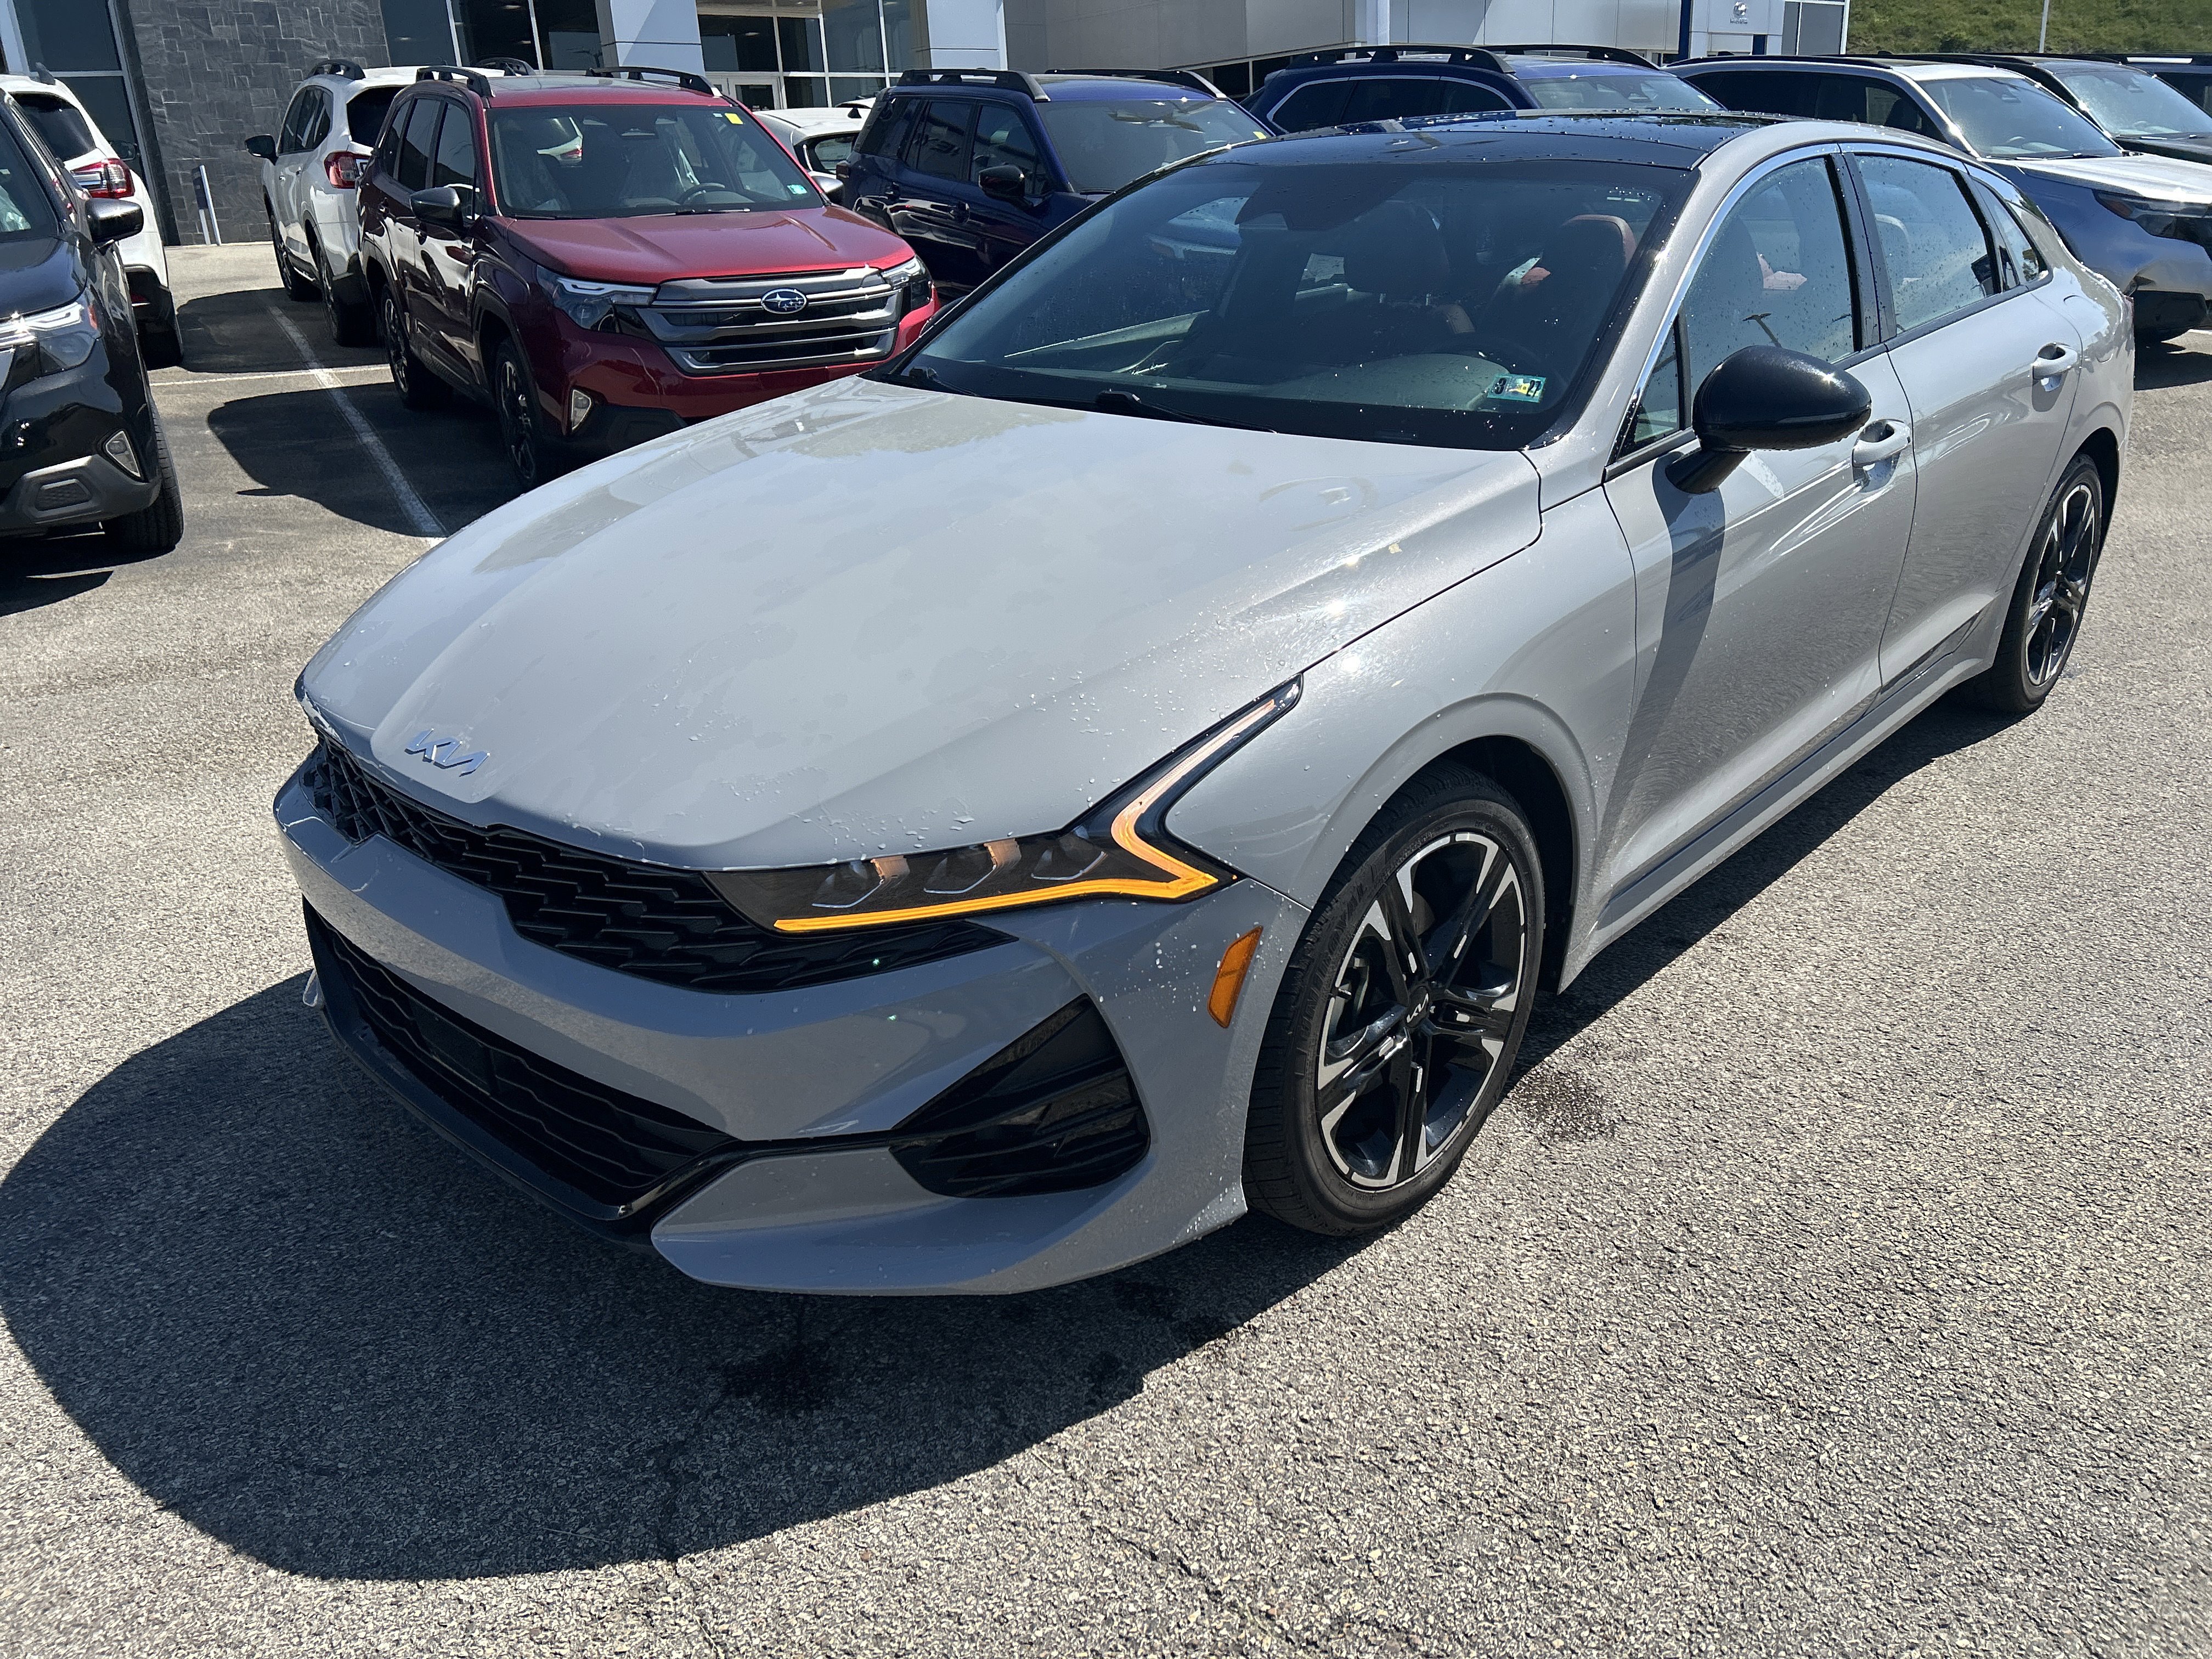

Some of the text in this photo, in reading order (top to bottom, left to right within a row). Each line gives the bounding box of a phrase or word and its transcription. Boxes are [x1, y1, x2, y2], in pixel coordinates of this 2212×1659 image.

[1494, 377, 1541, 398] 3 27
[404, 729, 490, 777] KIA
[1406, 993, 1429, 1023] KIA
